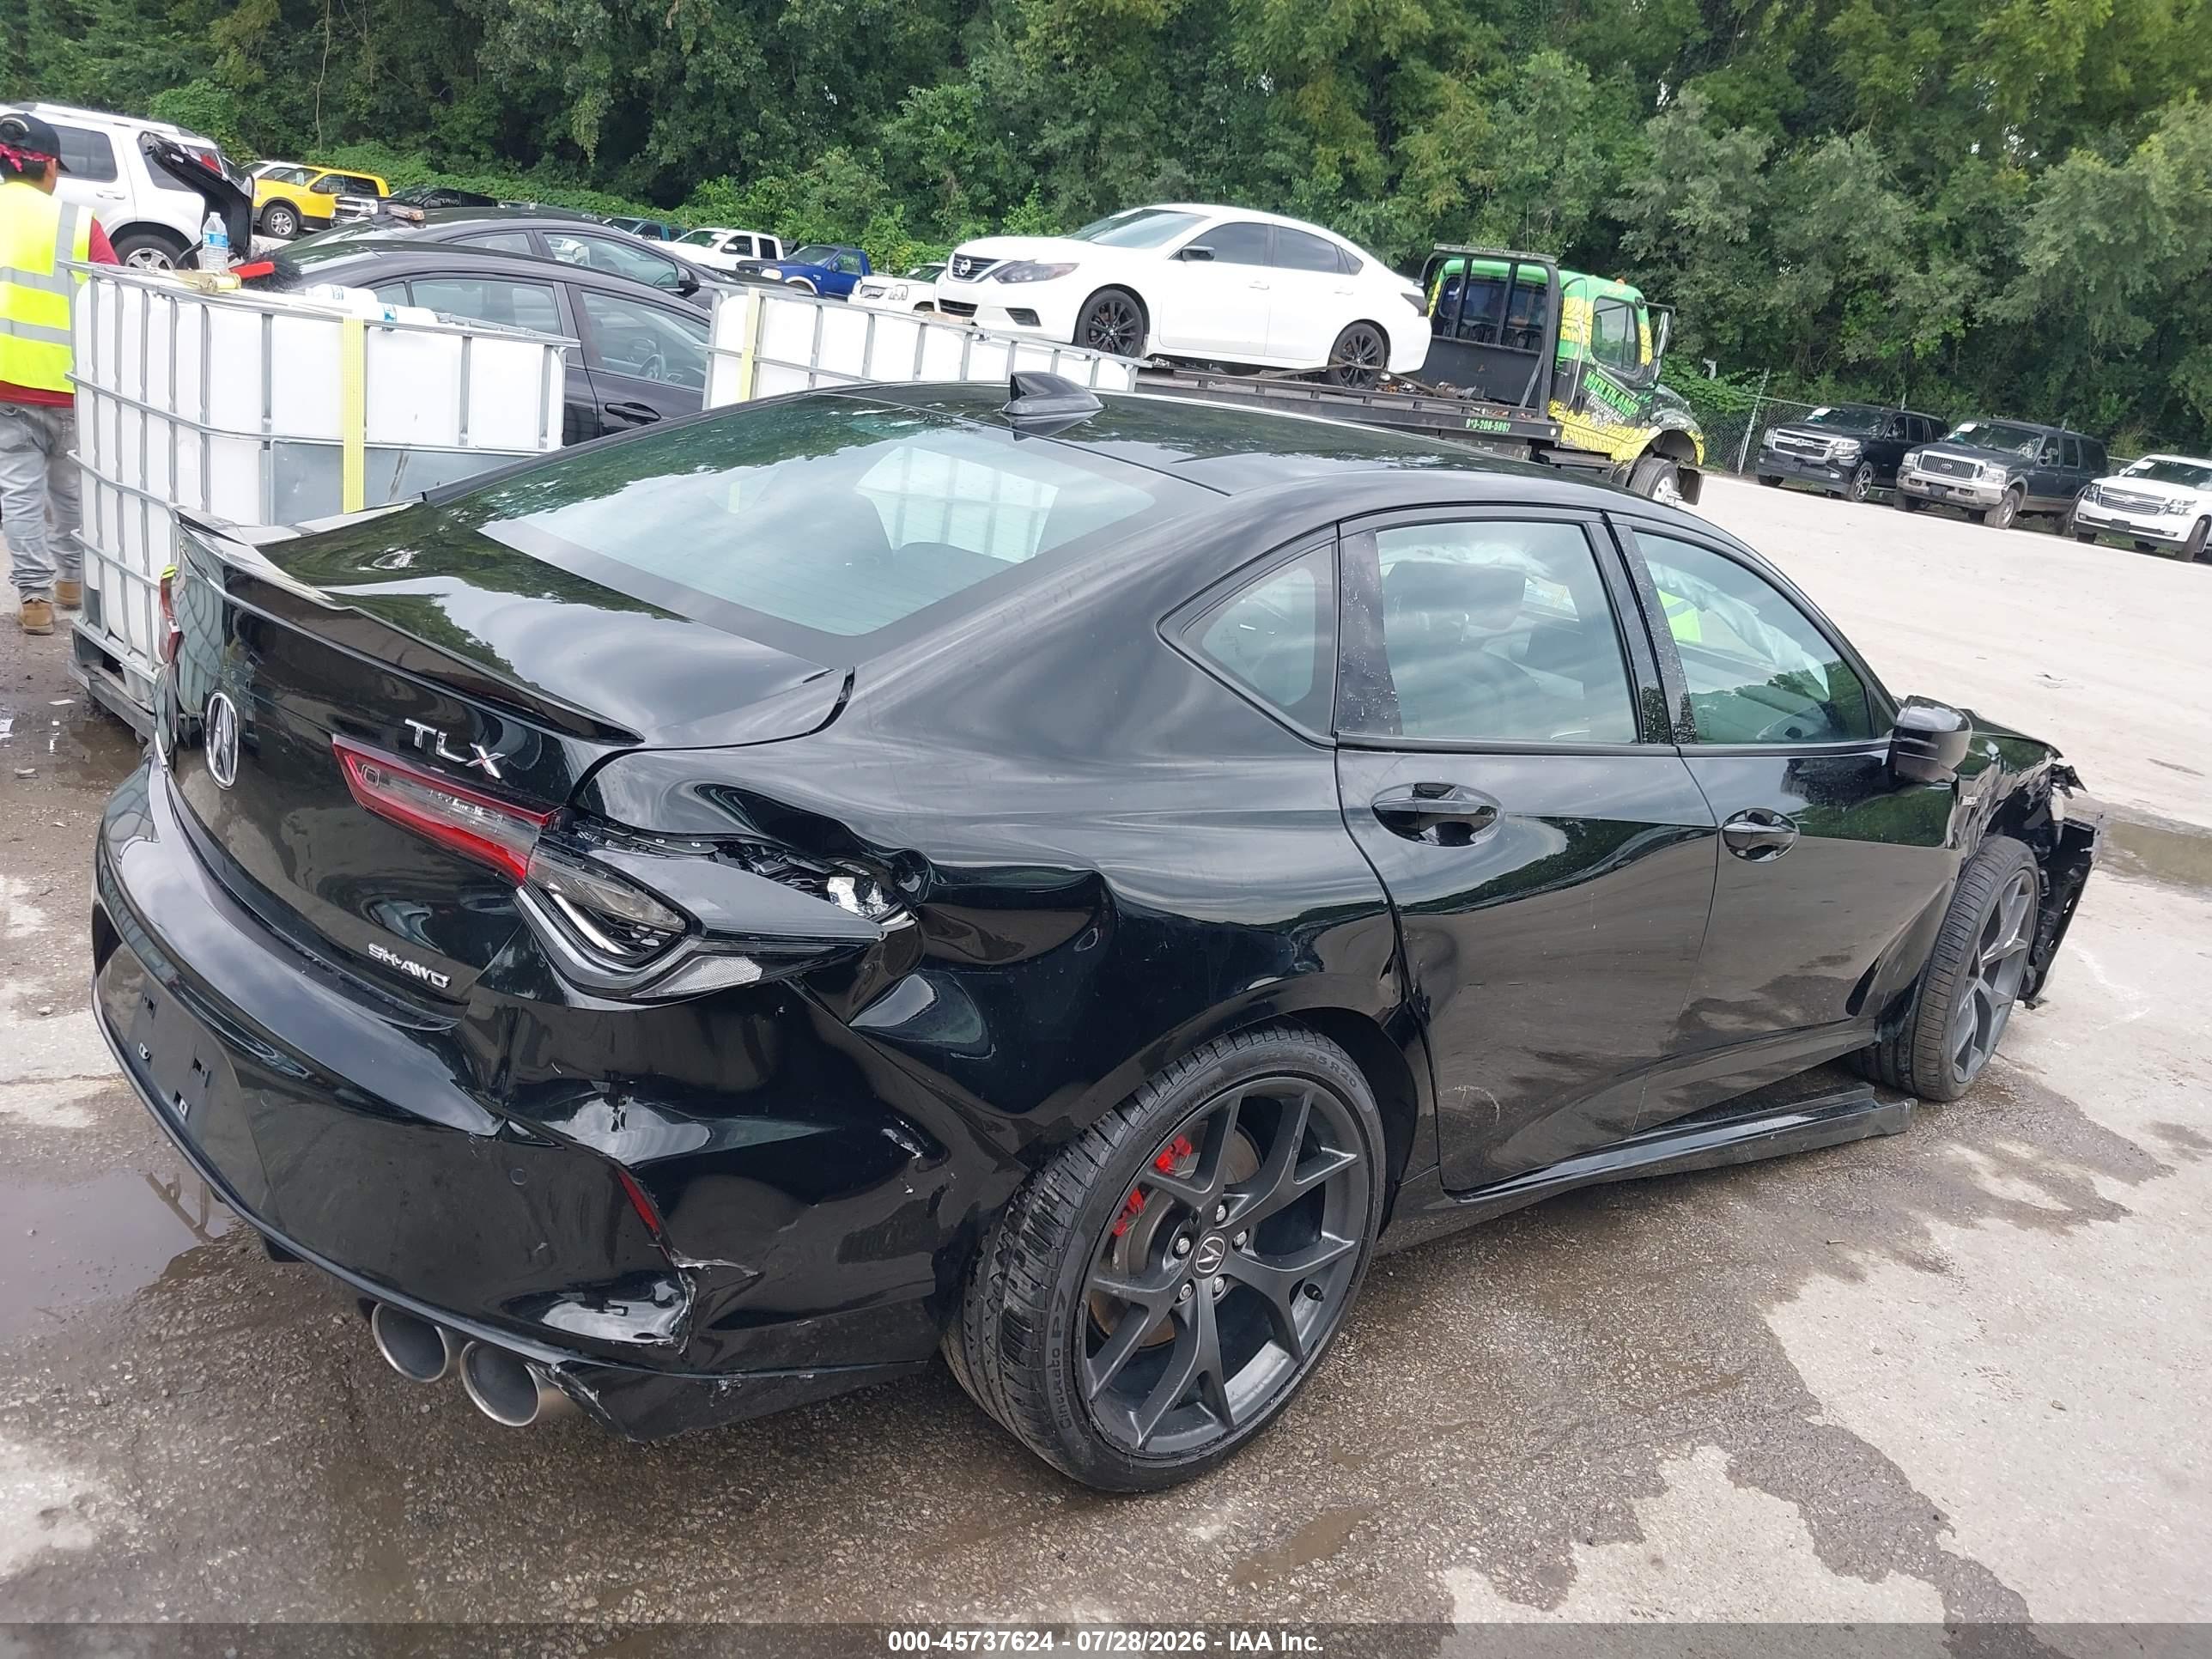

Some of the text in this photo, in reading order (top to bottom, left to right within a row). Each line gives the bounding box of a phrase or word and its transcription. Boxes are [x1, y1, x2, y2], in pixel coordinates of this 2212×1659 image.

[404, 718, 507, 780] TLX
[368, 943, 451, 989] SH-AWD
[1046, 1288, 1073, 1430] Cinturato P7
